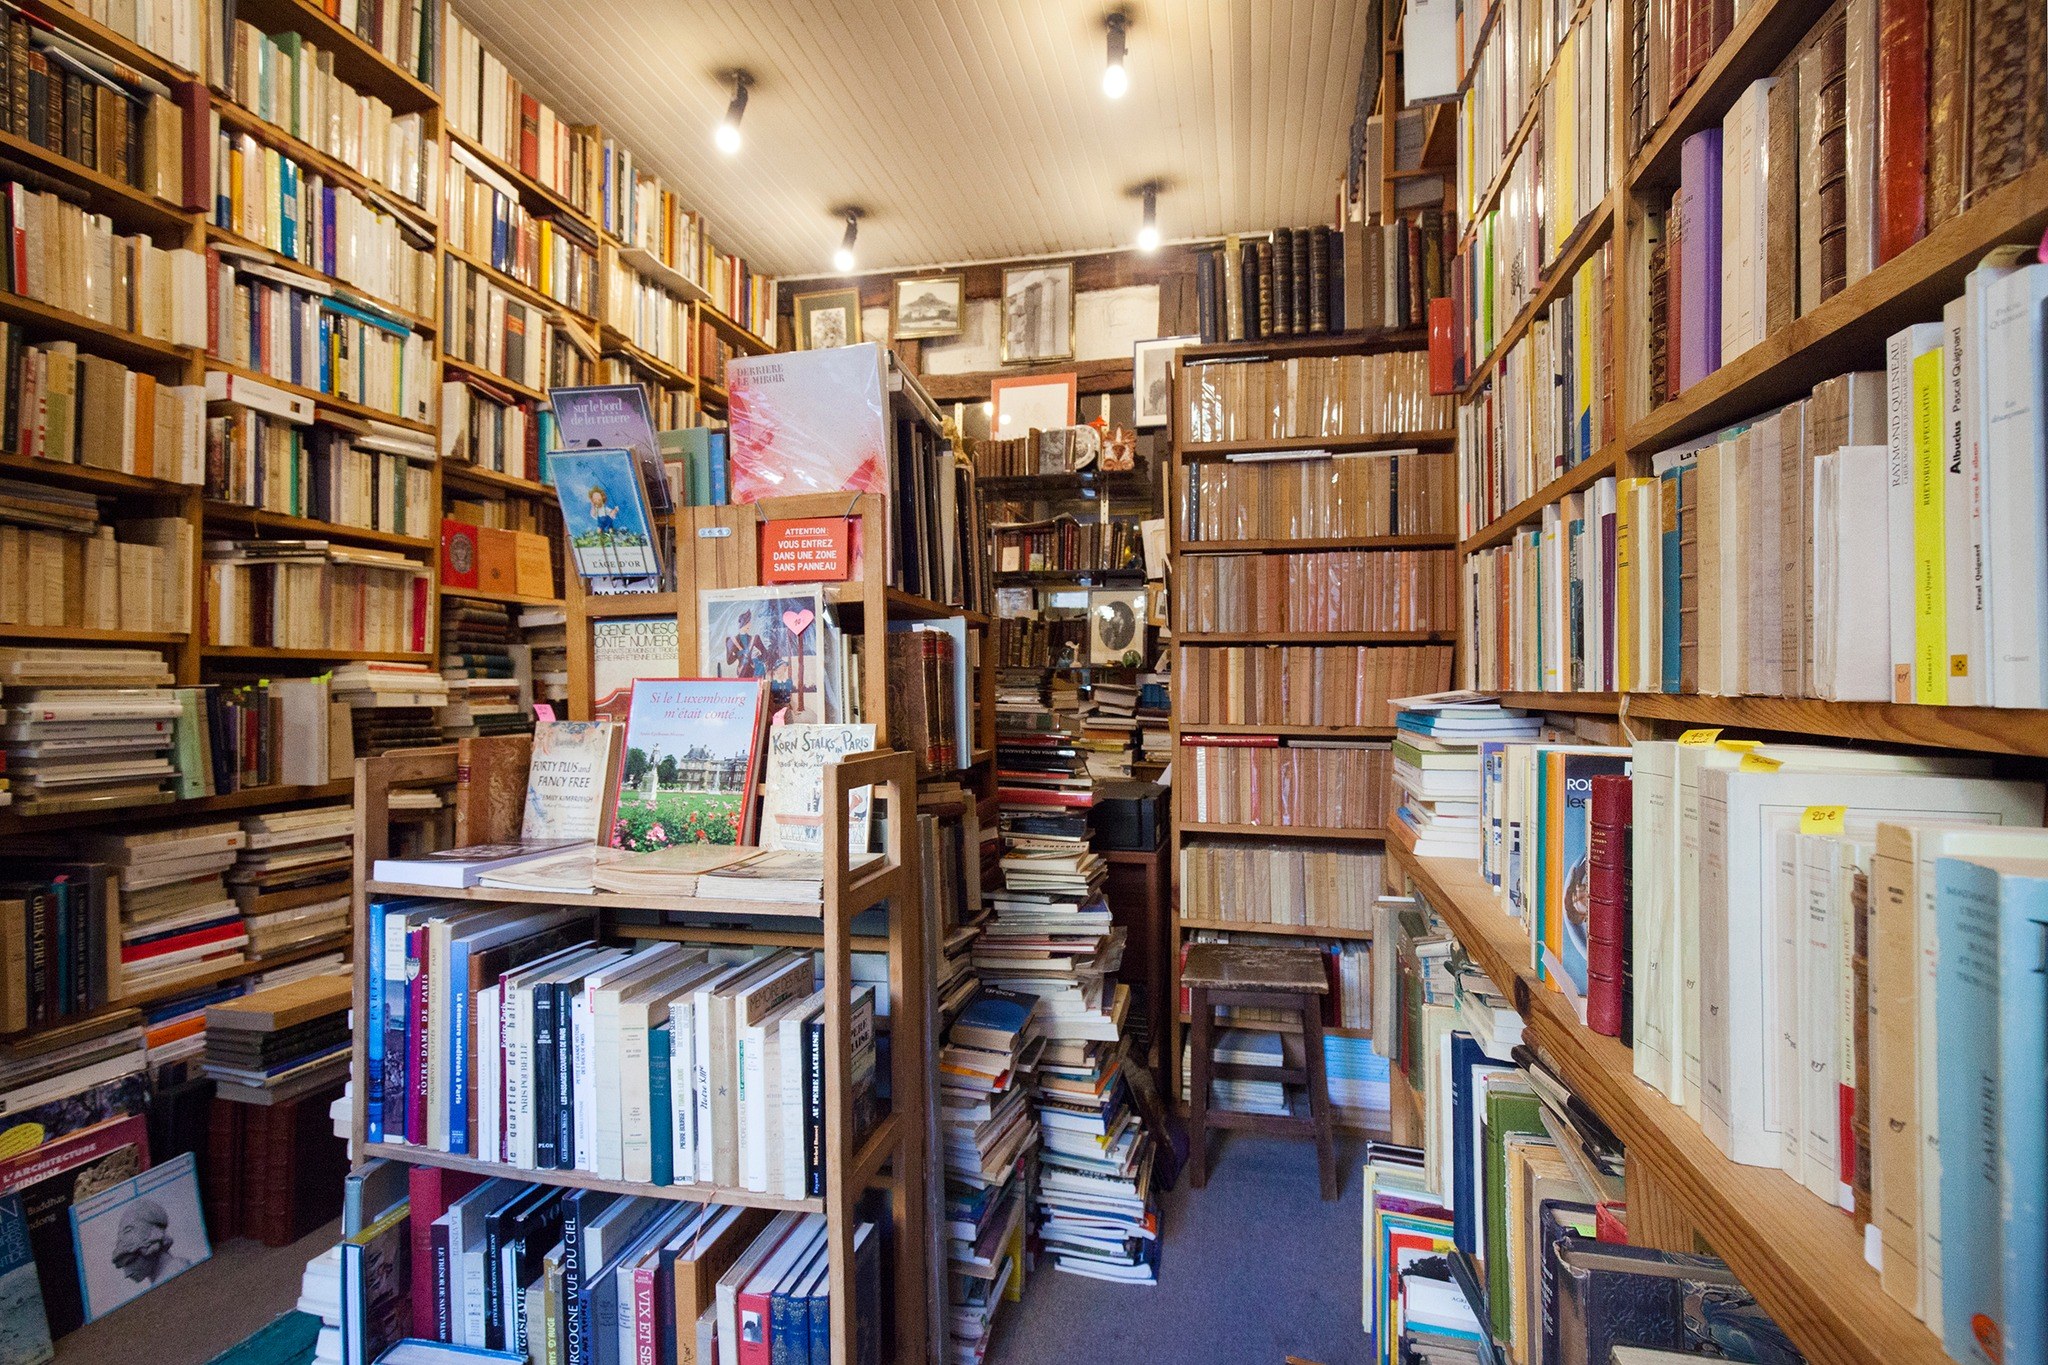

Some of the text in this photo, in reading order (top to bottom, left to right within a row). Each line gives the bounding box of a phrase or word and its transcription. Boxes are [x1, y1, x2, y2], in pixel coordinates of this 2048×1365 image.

[736, 364, 784, 376] DERRIERE
[737, 374, 786, 386] LE MIROIR
[573, 398, 622, 413] sur le bord
[1950, 326, 1963, 474] Albucius Pascal Quignard
[570, 411, 630, 426] de la rivière
[1890, 342, 1902, 488] RAYMOND QUENEAU
[1680, 452, 1692, 461] La
[784, 527, 826, 536] ATTENTION
[778, 539, 834, 549] VOUS ENTREZ
[773, 550, 837, 560] DANS UNE ZONE
[620, 560, 641, 568] D'OR
[774, 562, 837, 572] SANS PANNEAU
[1974, 544, 1983, 581] Quignard
[635, 622, 678, 635] IONESC
[594, 636, 626, 648] ONTE
[650, 692, 748, 708] Si le Luxembourg
[664, 708, 702, 719] m'était
[841, 730, 869, 751] PARIS
[815, 754, 825, 762] by
[532, 760, 592, 774] FORTY PLUS and
[538, 776, 592, 788] FANCY FREE
[1812, 810, 1836, 821] 20 €
[456, 993, 464, 1001] La
[508, 986, 516, 1028] halles
[420, 974, 429, 1096] NOTRE-DAME DE PARIS
[508, 1078, 516, 1138] quartier
[812, 1106, 819, 1118] AU
[508, 1152, 516, 1163] le
[565, 1217, 576, 1244] CIEL
[438, 1247, 445, 1257] LE
[566, 1248, 577, 1269] DU
[439, 1287, 446, 1298] DE
[566, 1273, 578, 1300] VUE
[638, 1290, 650, 1318] VIX
[516, 1287, 528, 1355] UGOSLAVIE
[547, 1317, 556, 1348] D'AUGE
[639, 1321, 651, 1344] ET
[640, 1344, 652, 1365] SE
